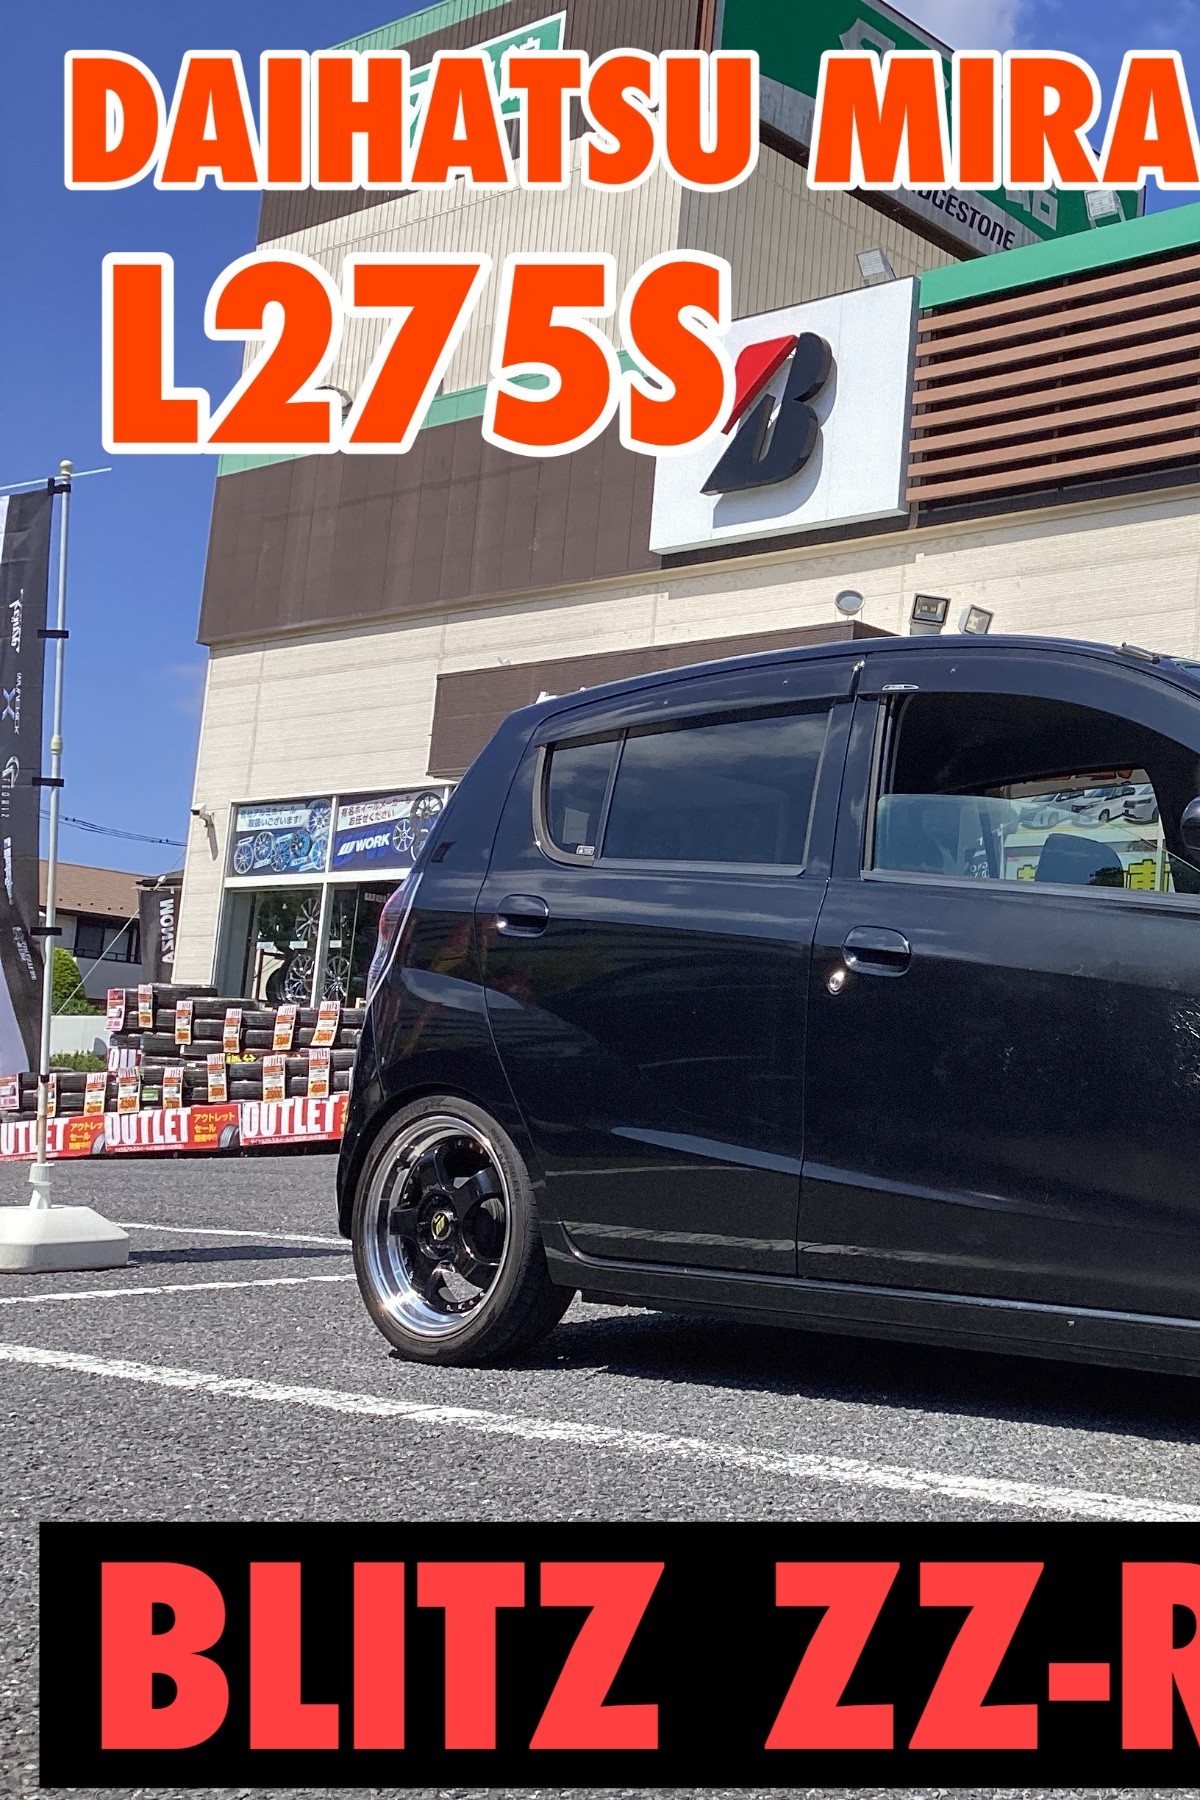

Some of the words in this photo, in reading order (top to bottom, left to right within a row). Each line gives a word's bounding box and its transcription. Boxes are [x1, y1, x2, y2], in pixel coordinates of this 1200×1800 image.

[355, 832, 391, 853] WORK
[105, 1107, 191, 1145] OUTLET
[194, 1112, 236, 1123] アウトレット
[242, 1095, 341, 1137] OUTLET
[194, 1124, 216, 1133] セール
